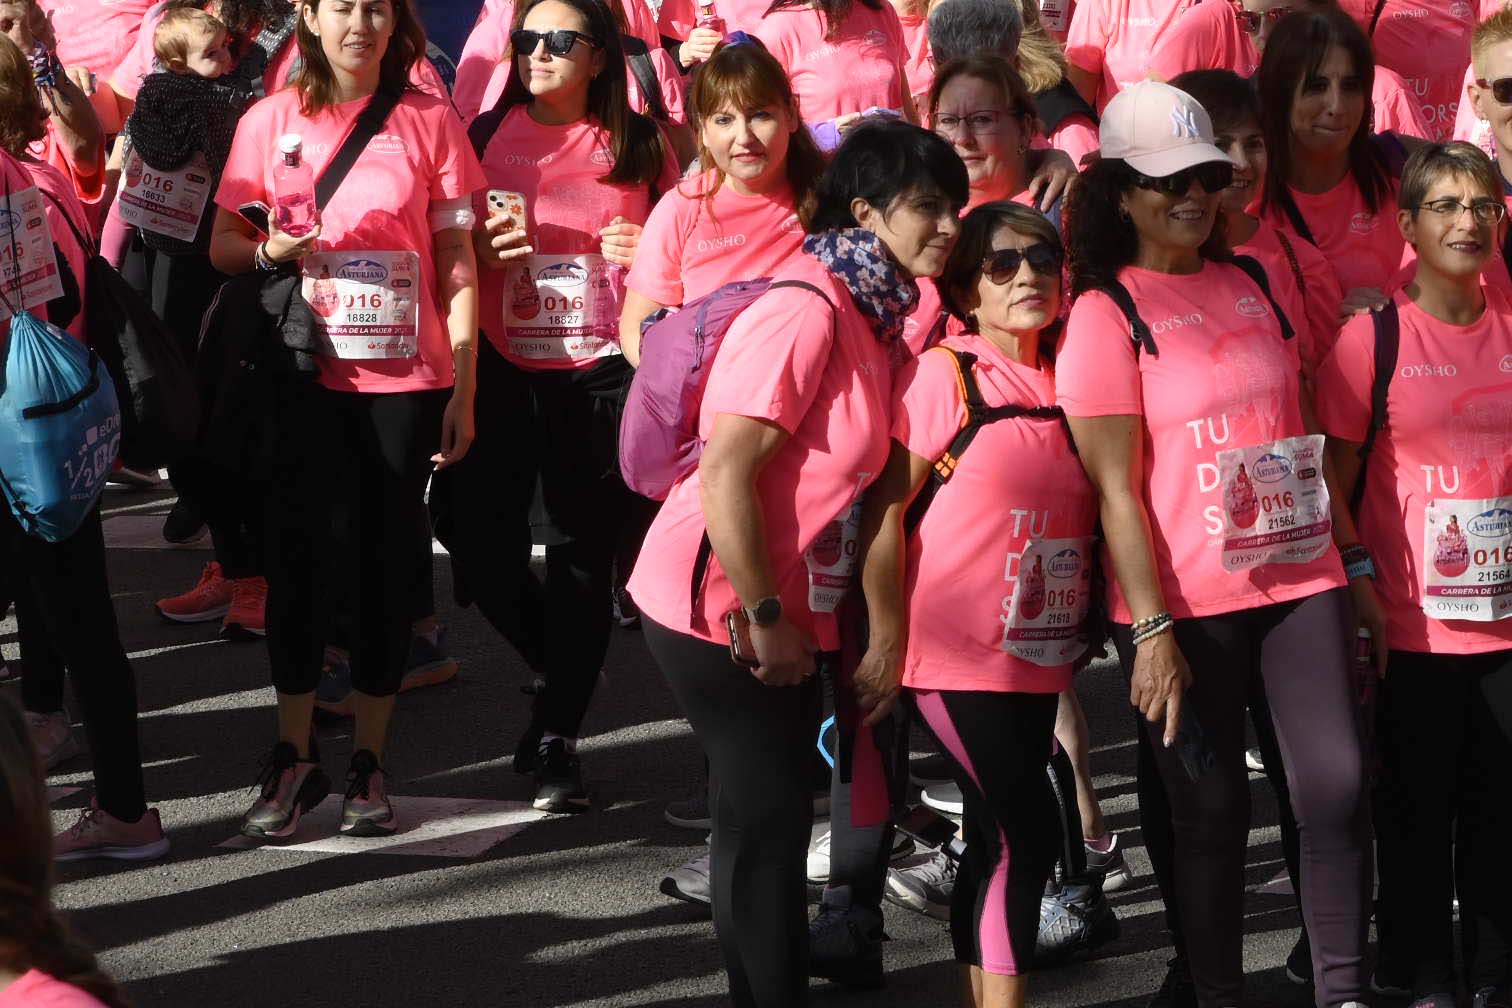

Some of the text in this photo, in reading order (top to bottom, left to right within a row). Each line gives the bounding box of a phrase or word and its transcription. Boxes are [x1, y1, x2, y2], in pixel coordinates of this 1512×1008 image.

[1392, 8, 1429, 20] OYSHO
[142, 172, 174, 193] 016
[697, 233, 747, 252] OYSHO
[339, 269, 385, 280] ASTURIANA
[544, 295, 584, 312] 016
[346, 313, 378, 323] 18828
[547, 315, 579, 325] 18827
[1151, 312, 1204, 335] OYSHO
[1400, 364, 1458, 379] OYSHO
[1185, 413, 1231, 449] TU
[1420, 464, 1460, 495] TU
[1261, 491, 1296, 514] 016
[1009, 508, 1049, 539] TU
[1267, 515, 1297, 531] 21562
[1477, 569, 1512, 583] 21564
[1047, 589, 1076, 608] 016
[1440, 587, 1480, 596] CARRERA
[1480, 586, 1492, 595] DE
[1436, 601, 1480, 614] OYSHO
